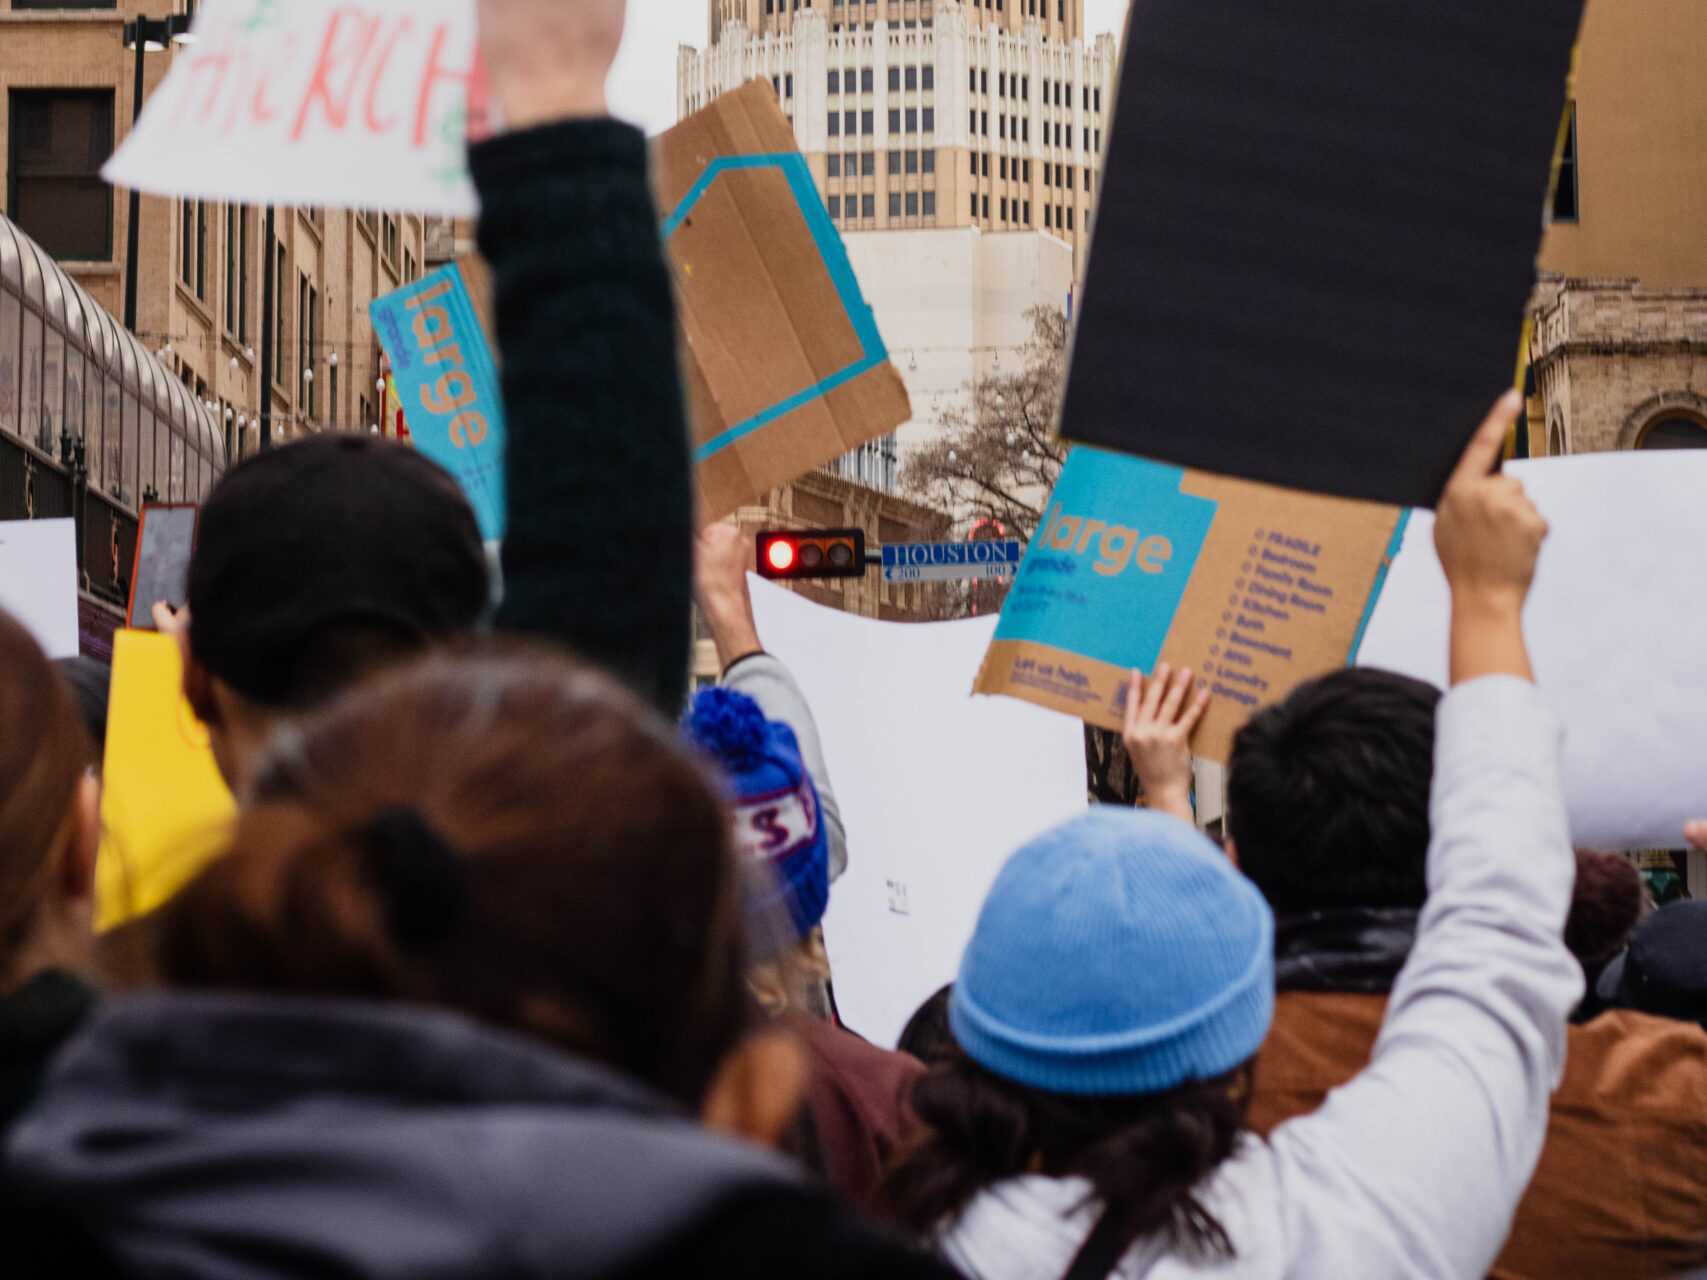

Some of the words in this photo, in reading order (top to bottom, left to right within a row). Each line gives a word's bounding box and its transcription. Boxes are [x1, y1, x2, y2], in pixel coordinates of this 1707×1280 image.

[288, 3, 492, 150] RICH
[403, 279, 488, 450] large
[1038, 501, 1174, 578] large
[1268, 530, 1321, 557] FRAGILE
[894, 542, 1008, 566] HOUSTON
[1261, 548, 1317, 573] Bedroom
[1243, 598, 1290, 620] Kitchen
[1217, 666, 1269, 691] Laundry
